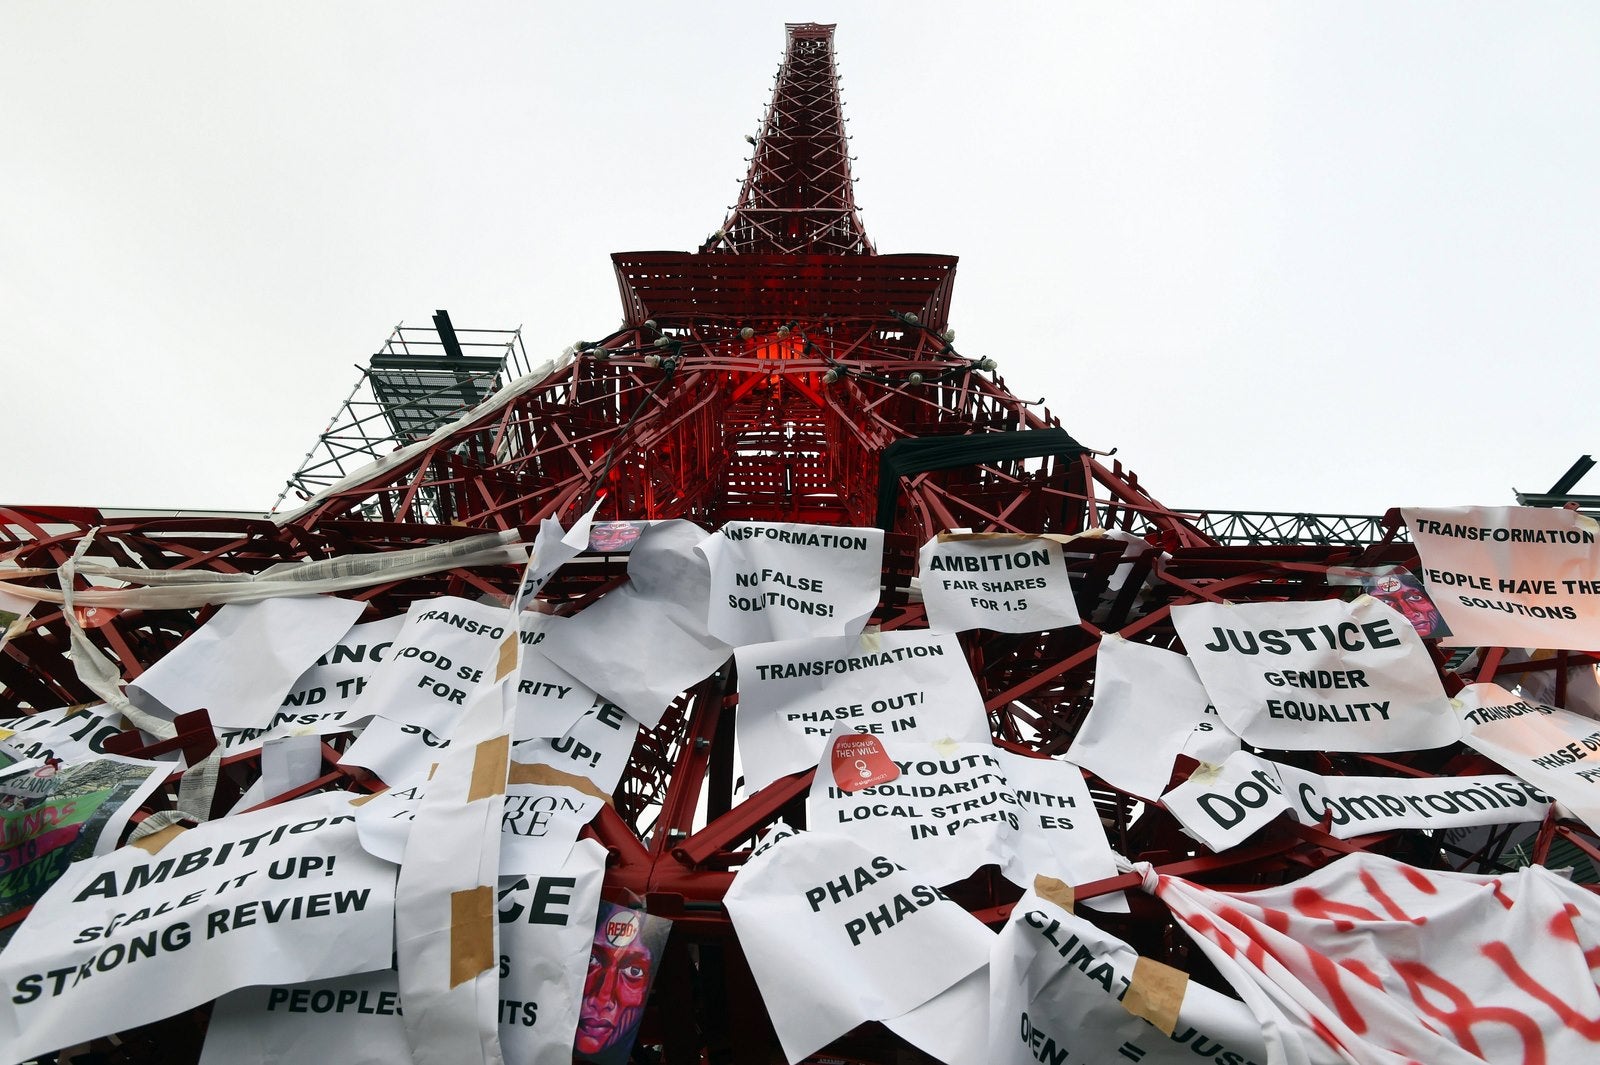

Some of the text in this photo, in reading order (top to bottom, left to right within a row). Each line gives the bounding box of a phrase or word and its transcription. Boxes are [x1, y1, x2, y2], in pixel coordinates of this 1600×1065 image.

[720, 526, 867, 550] ANSFORMATION
[1416, 518, 1595, 544] TRANSFORMATION
[930, 549, 1051, 572] AMBITION
[736, 569, 823, 593] NO FALSE
[943, 577, 1047, 593] FAIR SHARES
[1425, 568, 1600, 595] EOPLE HAVE THE
[728, 592, 834, 617] SOLUTIONS!
[971, 598, 1028, 612] FOR 1.5
[1458, 595, 1577, 620] SOLUTIONS
[1204, 619, 1401, 656] JUSTICE
[394, 646, 453, 671] FOOD
[756, 645, 944, 681] TRANSFORMATION
[417, 675, 467, 705] FOR
[1264, 669, 1369, 689] GENDER
[787, 692, 924, 722] PHASE OUT/
[1266, 699, 1391, 722] EQUALITY
[805, 716, 917, 738] PHSE IN
[550, 737, 602, 768] UP!
[836, 747, 879, 758] THEY WILL
[852, 741, 865, 749] SIGN
[1531, 742, 1588, 770] PHASE
[894, 754, 1000, 776] YOUTH
[828, 786, 853, 799] IN
[862, 774, 1007, 798] SOLIDARITY
[838, 805, 923, 823] LOCAL
[910, 810, 1020, 840] IN PARIS
[215, 870, 258, 896] IT
[268, 855, 336, 881] UP!
[12, 888, 371, 1005] STRONG REVIEW
[1025, 910, 1131, 1002] CLIMAT
[267, 988, 404, 1017] PEOPLE
[1021, 1012, 1069, 1065] OEN
